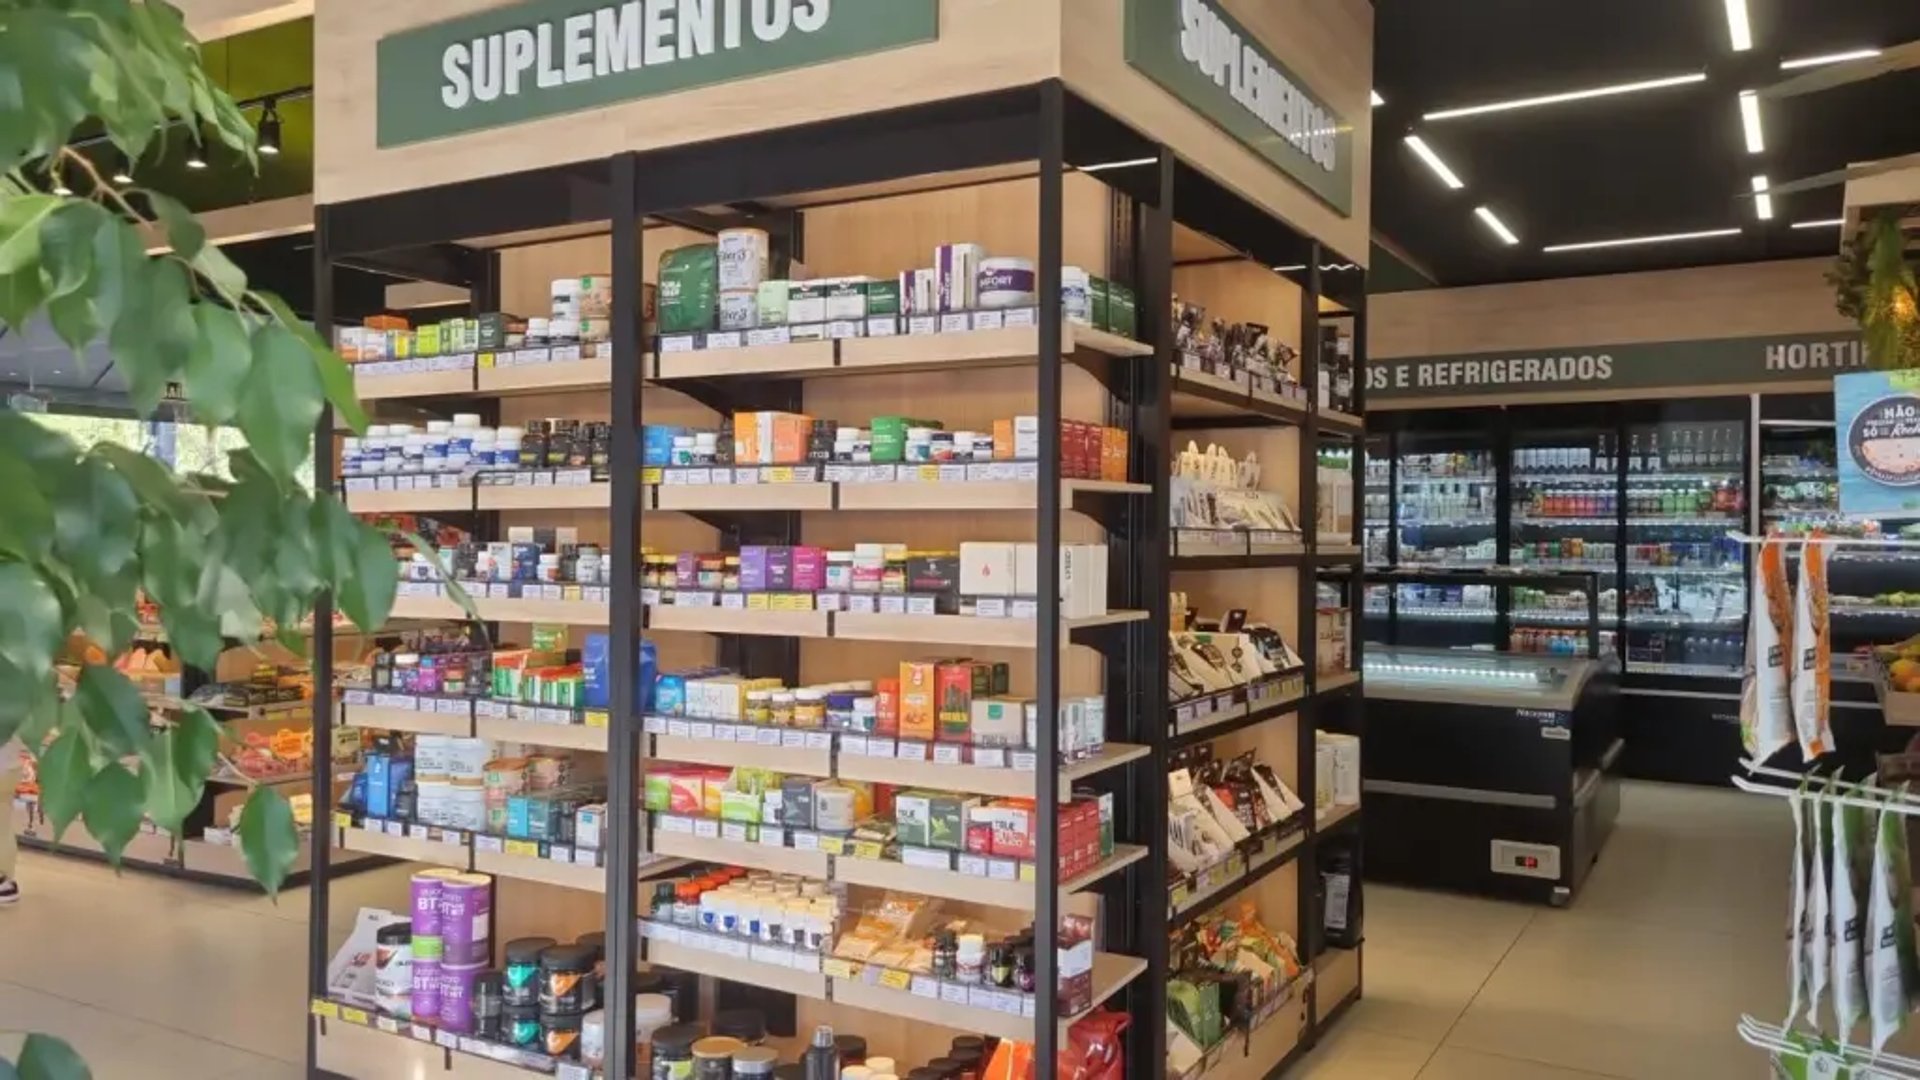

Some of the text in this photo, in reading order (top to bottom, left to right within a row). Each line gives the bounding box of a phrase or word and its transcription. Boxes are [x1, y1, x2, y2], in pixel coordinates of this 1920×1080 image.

[1181, 0, 1335, 171] SUPLEMENTOS
[1396, 365, 1409, 387] E
[1418, 355, 1613, 386] REFRIGERADOS
[1884, 404, 1915, 419] NÃO
